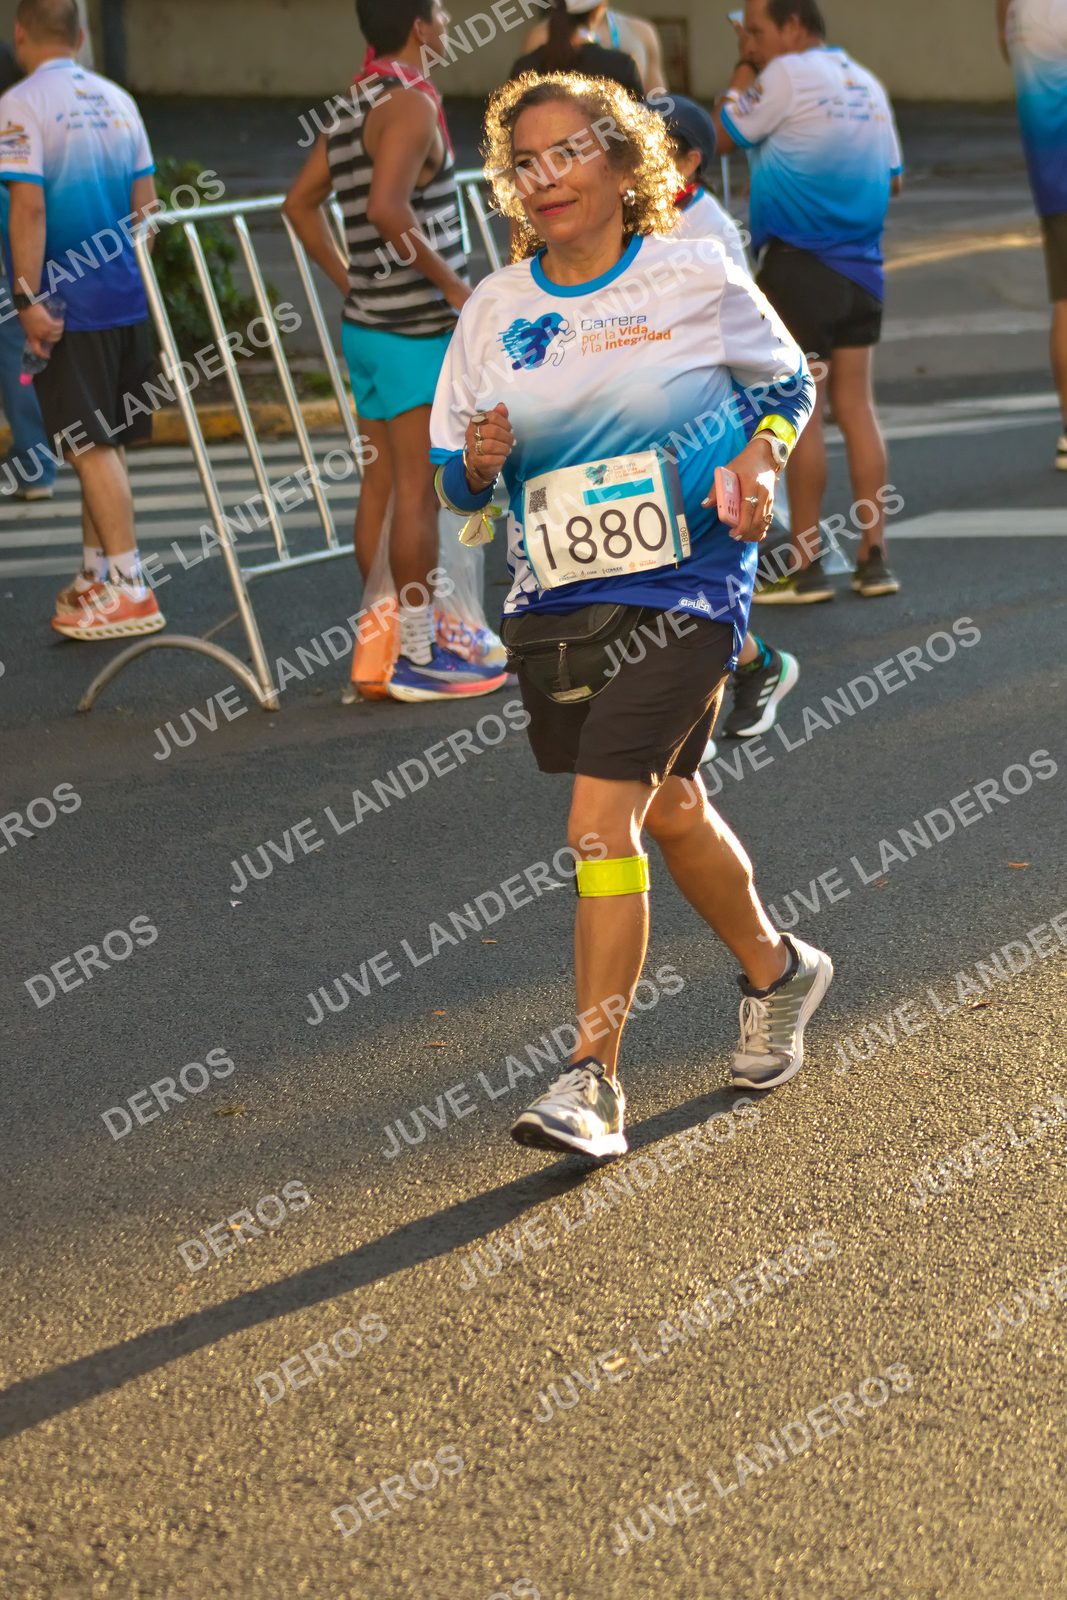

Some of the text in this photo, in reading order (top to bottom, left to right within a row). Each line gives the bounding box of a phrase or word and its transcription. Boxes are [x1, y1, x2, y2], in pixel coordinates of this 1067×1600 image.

[581, 315, 647, 331] Carrera
[582, 333, 600, 346] por
[605, 329, 616, 340] la
[582, 329, 672, 357] y la Integridad
[535, 502, 667, 571] 1880
[680, 526, 689, 547] 1880
